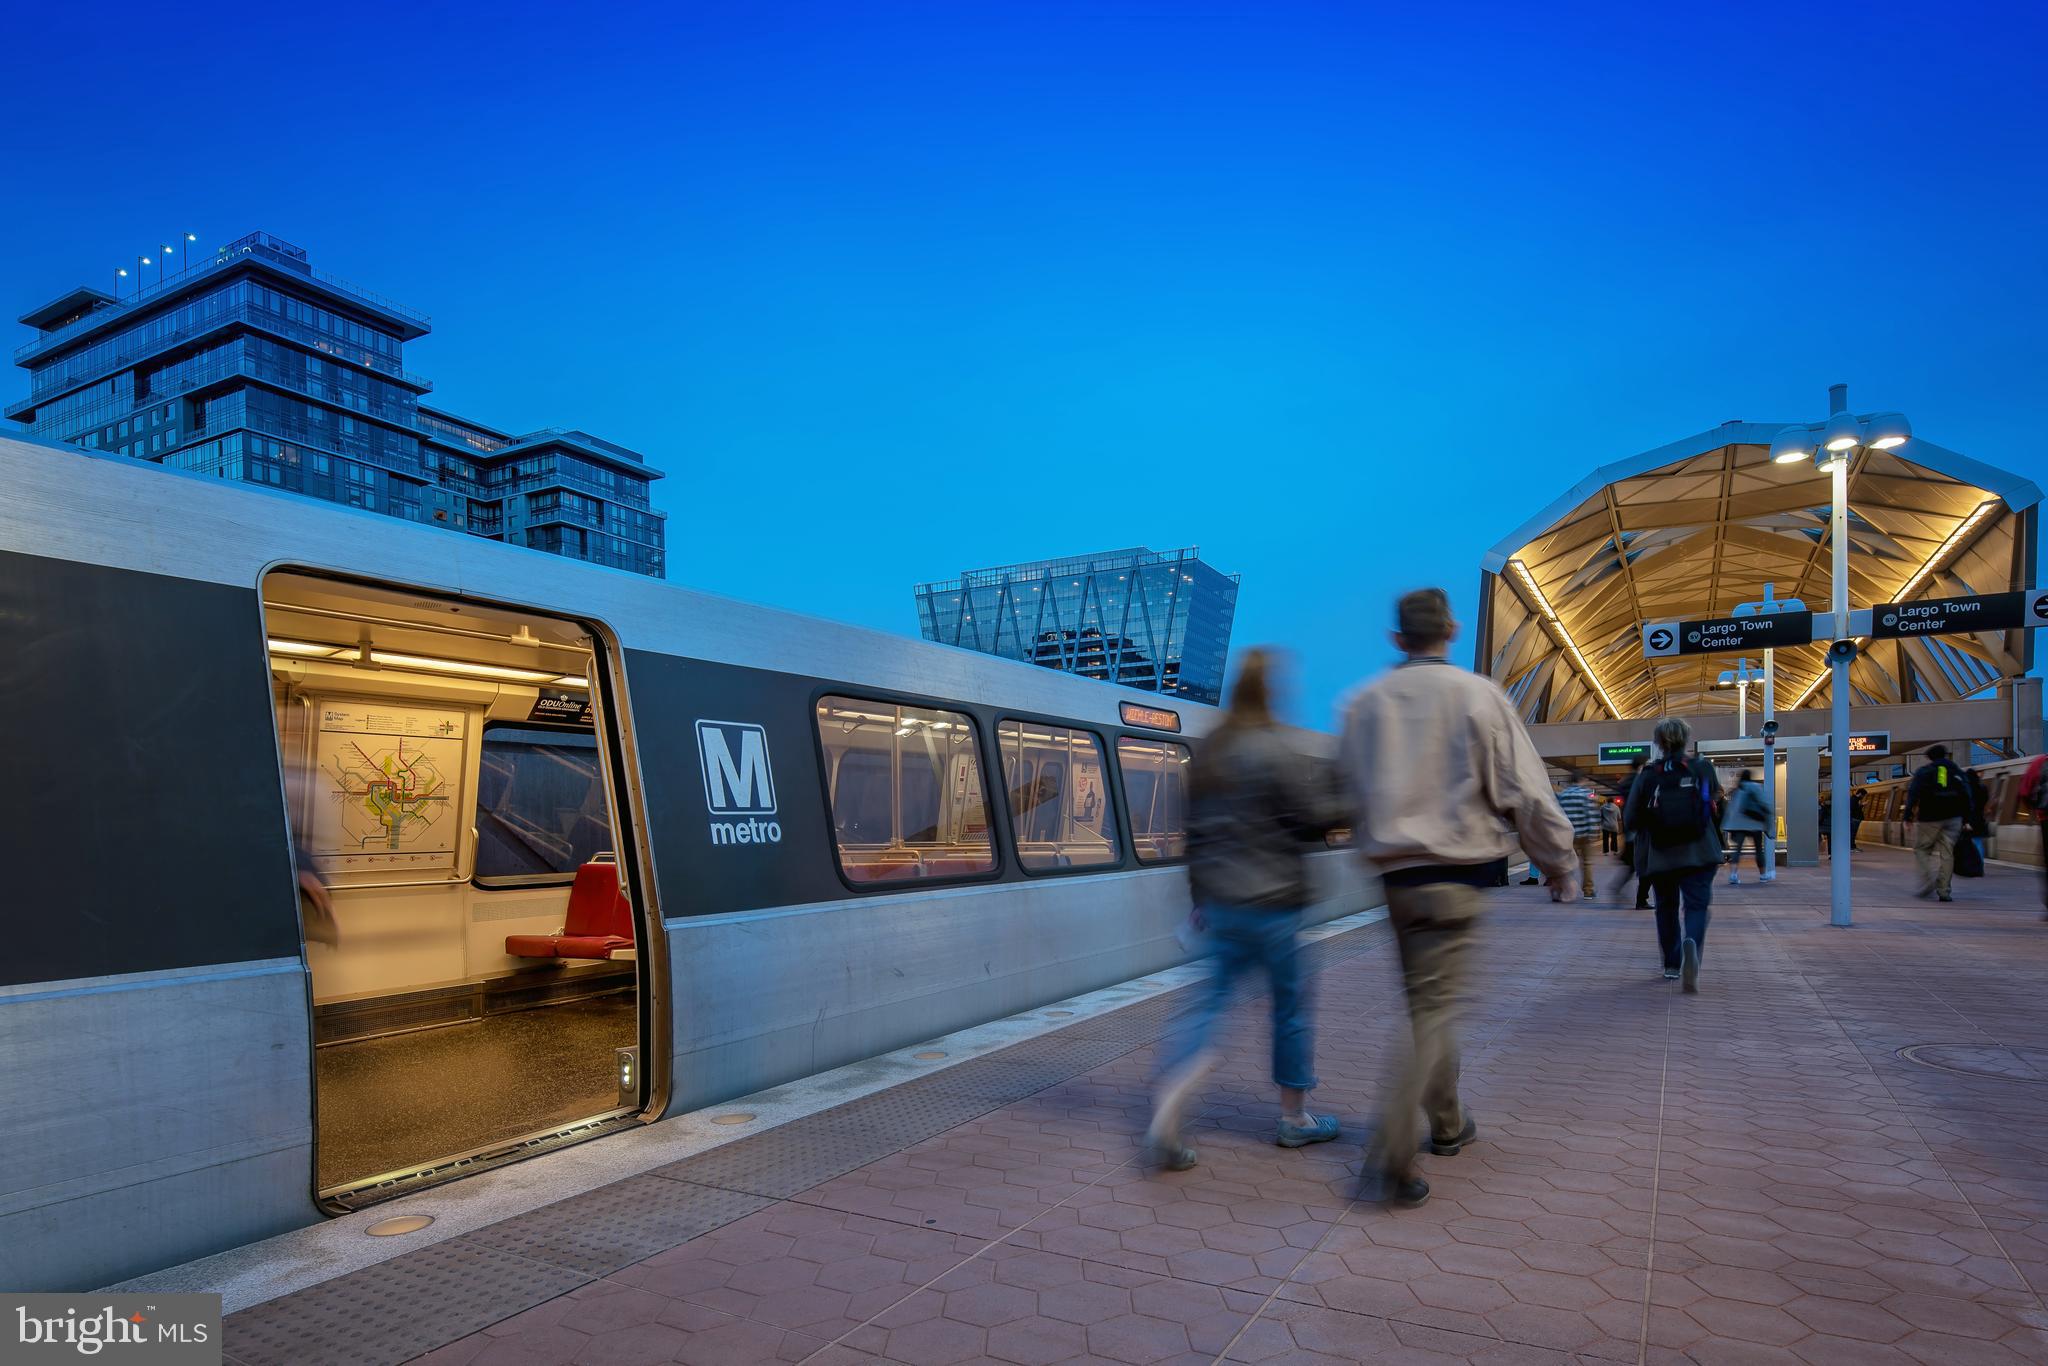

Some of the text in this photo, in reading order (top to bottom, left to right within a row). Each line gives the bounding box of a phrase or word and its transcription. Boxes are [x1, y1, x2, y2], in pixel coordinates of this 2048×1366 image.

[1899, 602, 1981, 617] Largo Town
[1702, 620, 1773, 635] Largo Town
[1898, 619, 1946, 631] Center
[1701, 637, 1743, 648] Center
[701, 726, 772, 808] M
[710, 817, 782, 845] metro
